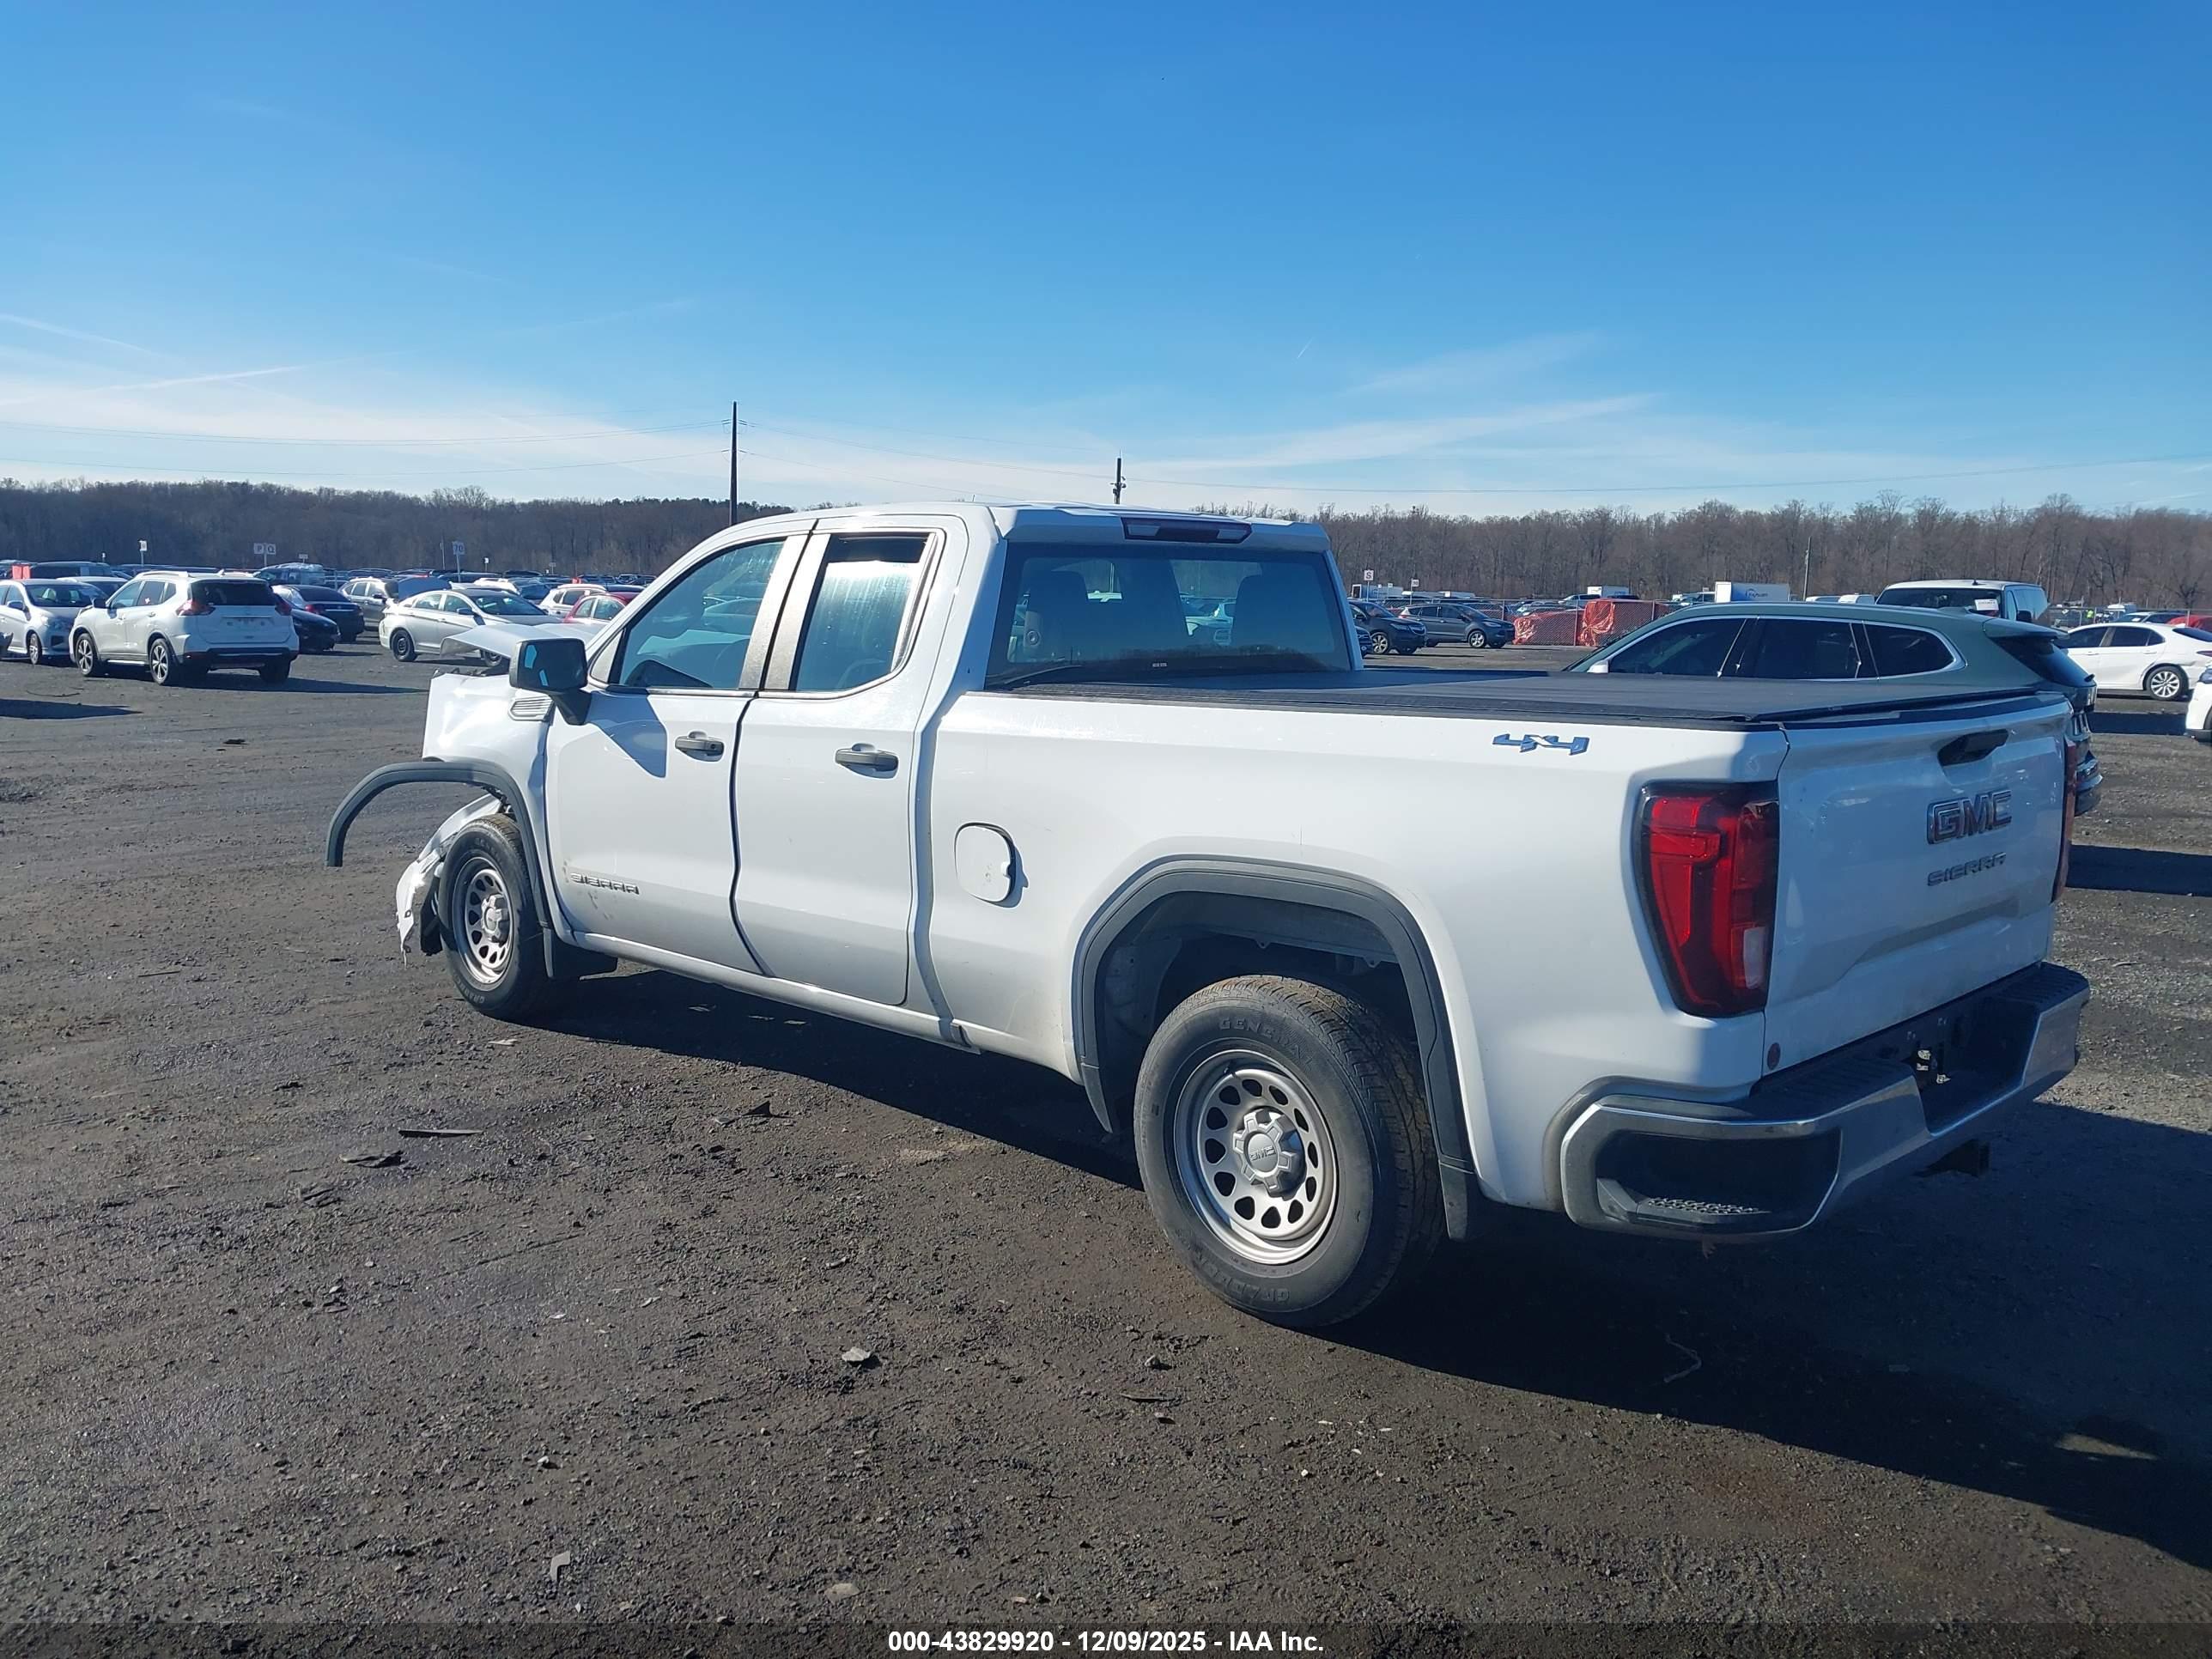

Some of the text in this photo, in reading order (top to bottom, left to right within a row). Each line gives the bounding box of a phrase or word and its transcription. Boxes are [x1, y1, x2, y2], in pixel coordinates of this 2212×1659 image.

[1927, 788, 2013, 845] GMC
[1927, 852, 2007, 886] SIERRA
[570, 872, 641, 896] SIERRA
[1249, 1146, 1276, 1161] GMC
